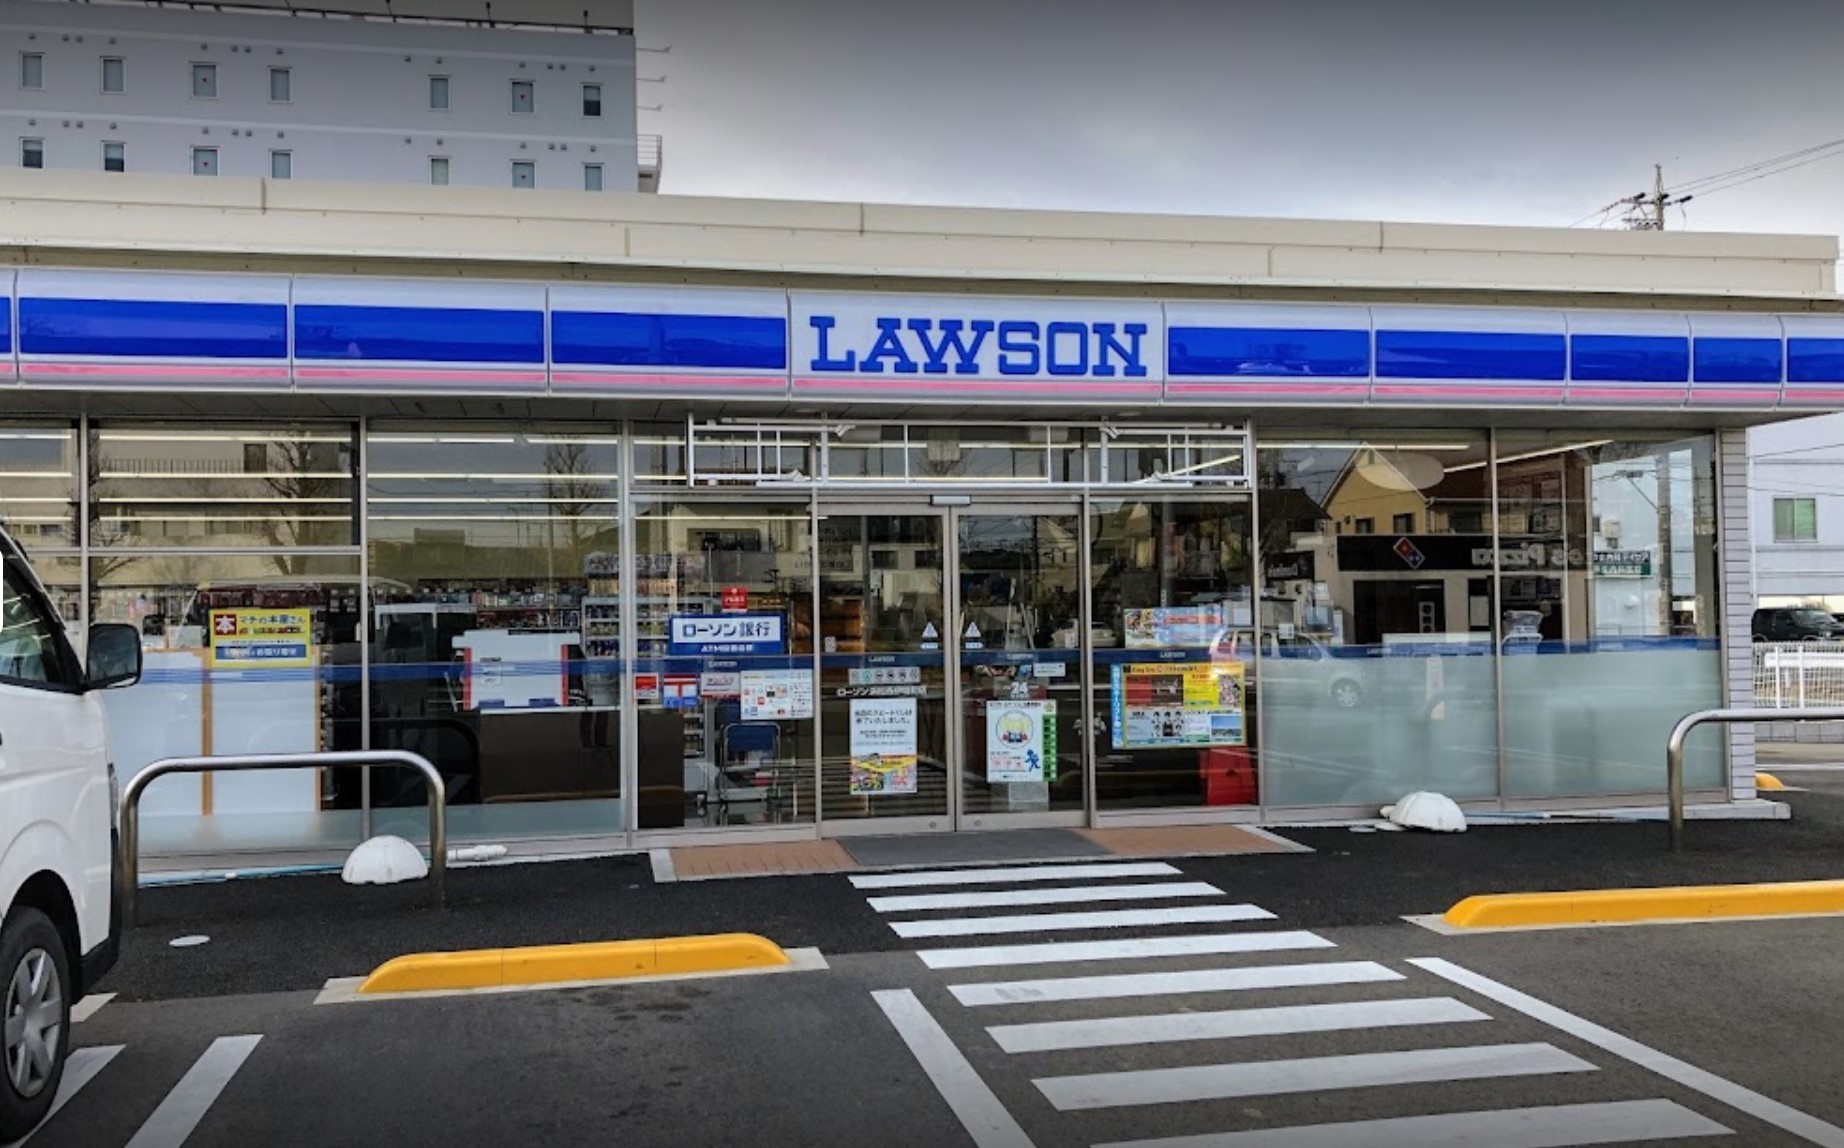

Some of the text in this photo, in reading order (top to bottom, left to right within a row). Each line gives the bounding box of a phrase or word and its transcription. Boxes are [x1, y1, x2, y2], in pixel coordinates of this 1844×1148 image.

[809, 316, 1147, 377] LAWSON
[682, 621, 771, 638] ローソン銀行
[1160, 651, 1186, 659] LAWSON
